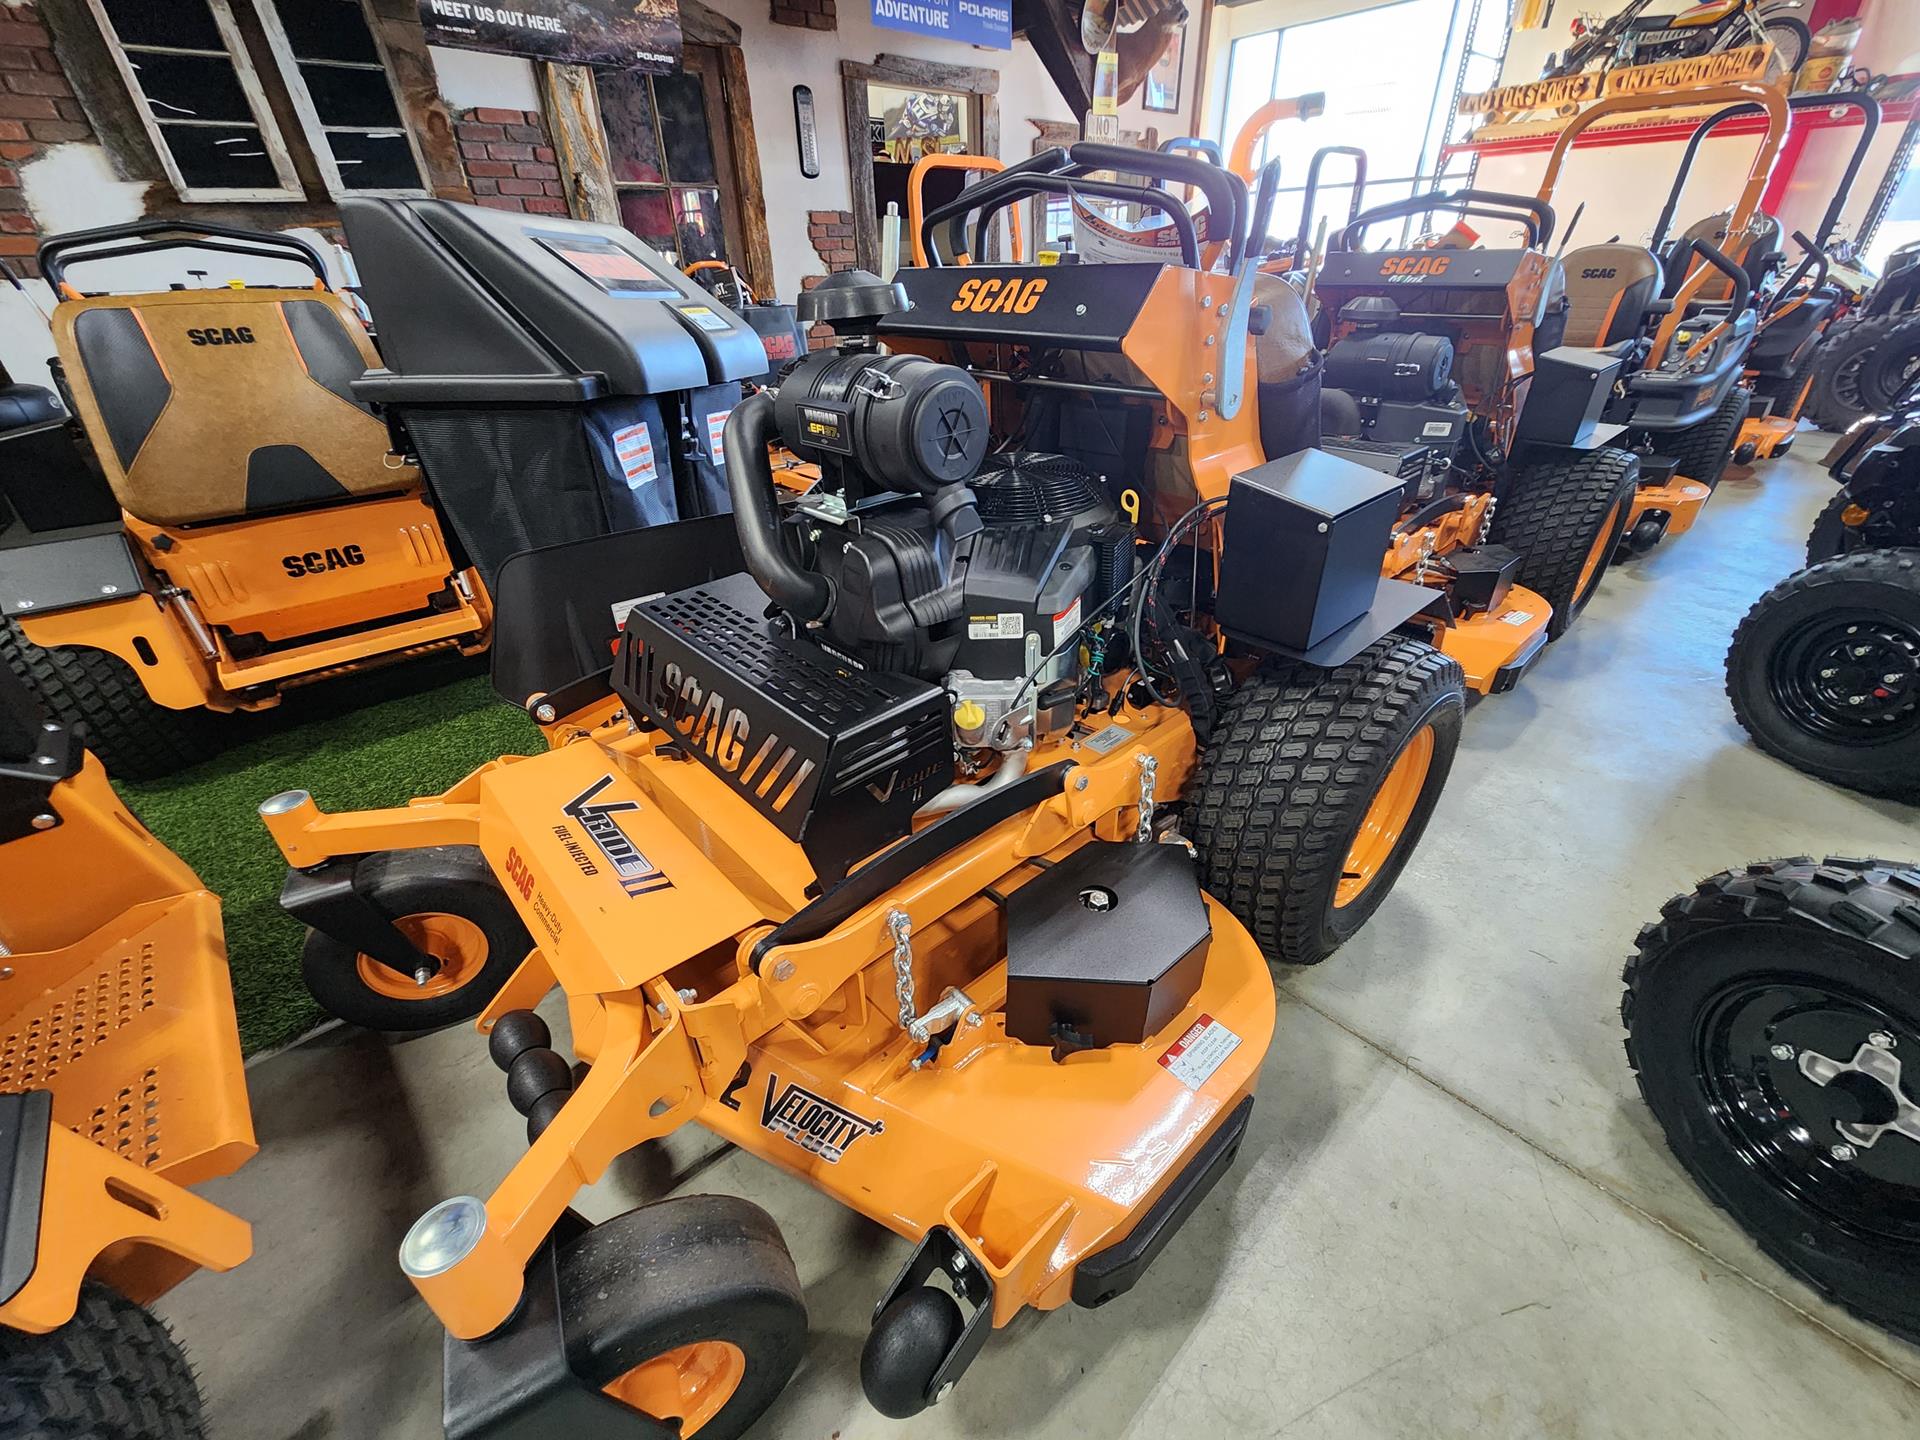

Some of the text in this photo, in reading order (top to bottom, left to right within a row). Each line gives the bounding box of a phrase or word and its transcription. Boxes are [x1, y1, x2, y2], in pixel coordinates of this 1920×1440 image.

[430, 0, 567, 34] MEET US OUT HERE.
[875, 0, 949, 29] ADVENTURE
[959, 2, 1009, 23] POLARIS
[636, 51, 674, 64] POLARIS
[1464, 50, 1756, 112] MOTORSPORTS INTERNATIONAL
[1096, 116, 1110, 135] NO
[1380, 256, 1451, 276] SCAG
[1581, 267, 1617, 279] SCAG
[951, 279, 1048, 314] SCAG
[187, 326, 256, 346] SCAG
[282, 544, 366, 578] SCAG
[656, 661, 751, 773] SCAG
[552, 825, 599, 877] FUEL-INJECTED
[506, 847, 535, 901] SCAG
[532, 901, 561, 946] Commercial
[536, 891, 564, 935] Heavy-Duty
[1179, 1022, 1206, 1050] DANGER
[767, 1117, 844, 1164] PLUS
